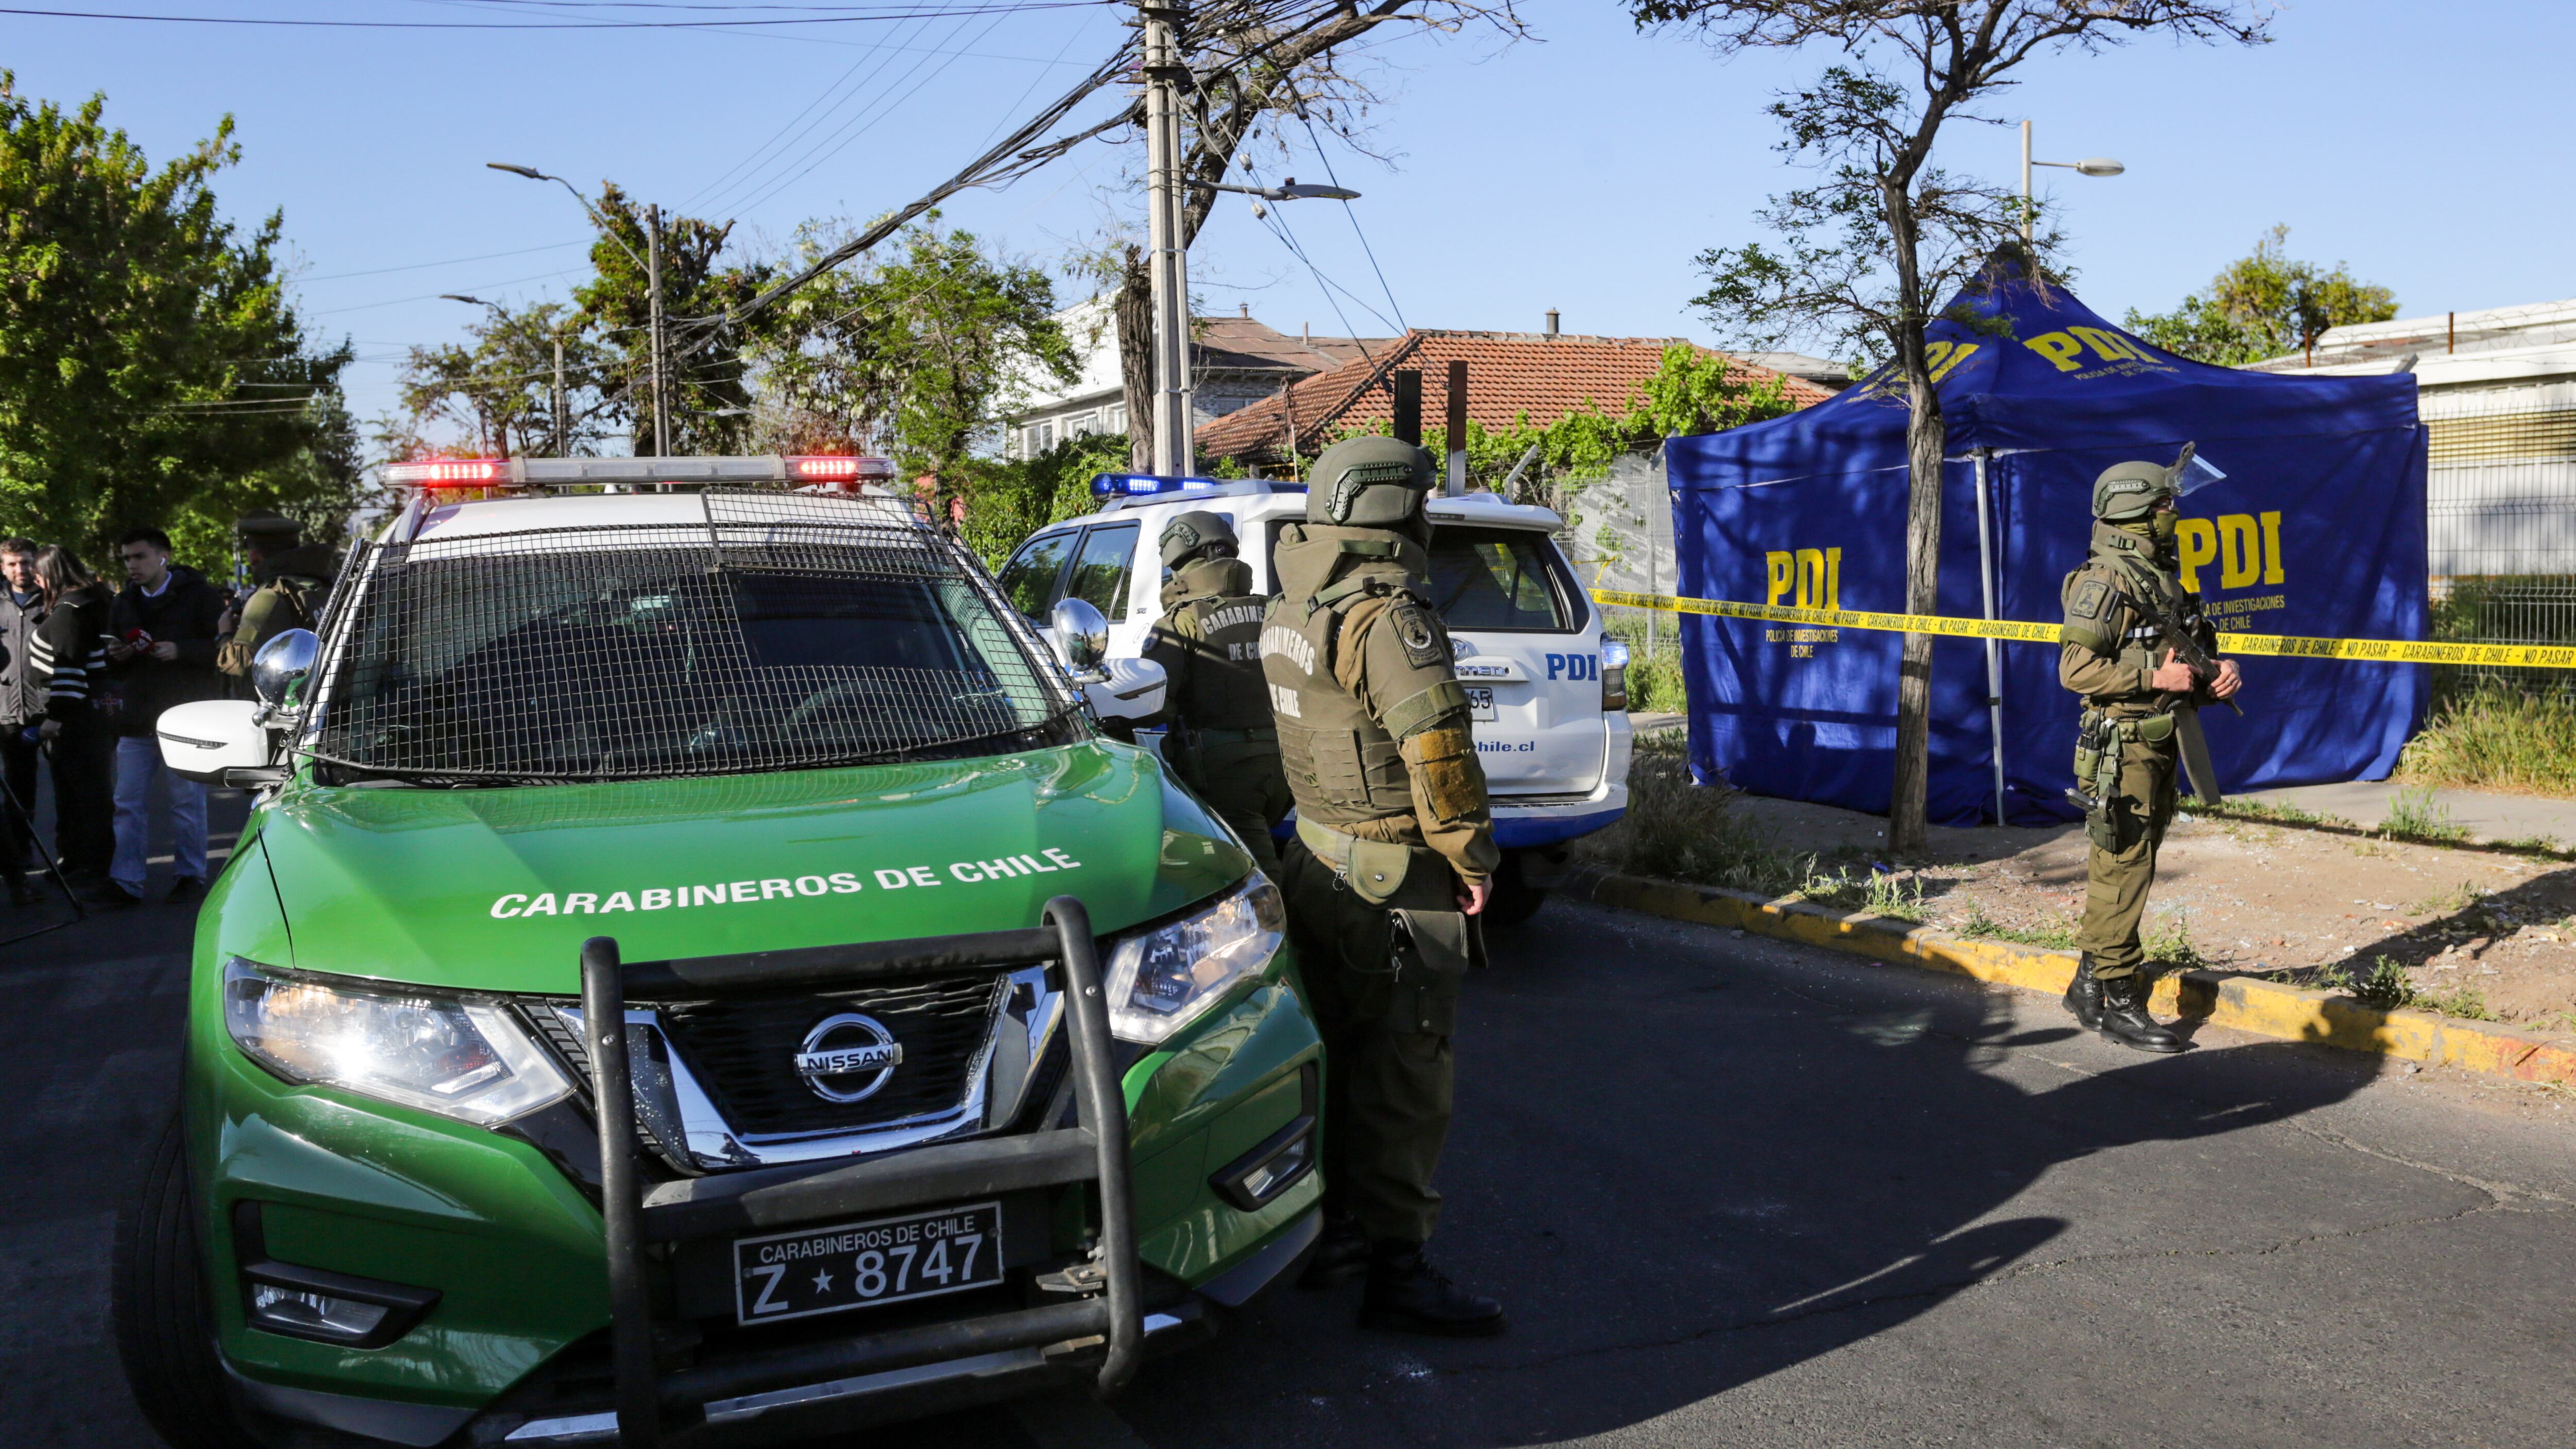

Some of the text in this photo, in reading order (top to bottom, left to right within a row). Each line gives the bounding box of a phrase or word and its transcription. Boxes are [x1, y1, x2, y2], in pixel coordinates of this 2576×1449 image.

[2022, 326, 2163, 372] PDI
[2174, 511, 2284, 594] PDI
[1766, 547, 1841, 610] PDI
[1200, 605, 1266, 634] CARABINE
[1681, 599, 1711, 613] CARABINEROS
[1713, 602, 1719, 613] DE
[1720, 602, 1733, 615] CHILE
[1738, 604, 1745, 616] NO
[1746, 605, 1762, 617] PASAR
[1769, 606, 1803, 620] CARABINEROS
[1804, 610, 1811, 621] DE
[1812, 611, 1827, 622] CHILE
[1833, 612, 1840, 624] NO
[1841, 613, 1860, 625] PASAR
[1867, 614, 1905, 629] CARABINEROS
[1906, 617, 1915, 630] DE
[1916, 617, 1933, 631] CHILE
[1939, 619, 1947, 632] NO
[1948, 620, 1970, 633] PASAR
[1977, 622, 2020, 637] CARABINEROS
[2022, 625, 2031, 637] DE
[2032, 625, 2051, 639] CHILE
[2212, 602, 2222, 616] DE
[2223, 595, 2285, 614] INVESTIGACIONES
[1786, 629, 1793, 642] DE
[1794, 629, 1838, 643] INVESTIGACIONES
[2219, 615, 2251, 632] DE CHILE
[1228, 643, 1243, 661] DE
[1791, 645, 1813, 658] DE CHILE
[2217, 635, 2574, 665] SAR CARABINEROS DE CHILE NO PASAR CARABINEROS DE CHILE NO PASAR
[1546, 653, 1597, 681] PDI
[1279, 686, 1301, 718] CHILE
[1475, 741, 1534, 752] hile.cl
[490, 848, 1081, 918] CARABINEROS DE CHILE
[807, 1049, 890, 1070] NISSAN
[760, 1216, 975, 1263] CARABINEROS DE CHILE
[753, 1233, 982, 1314] Z 8747
